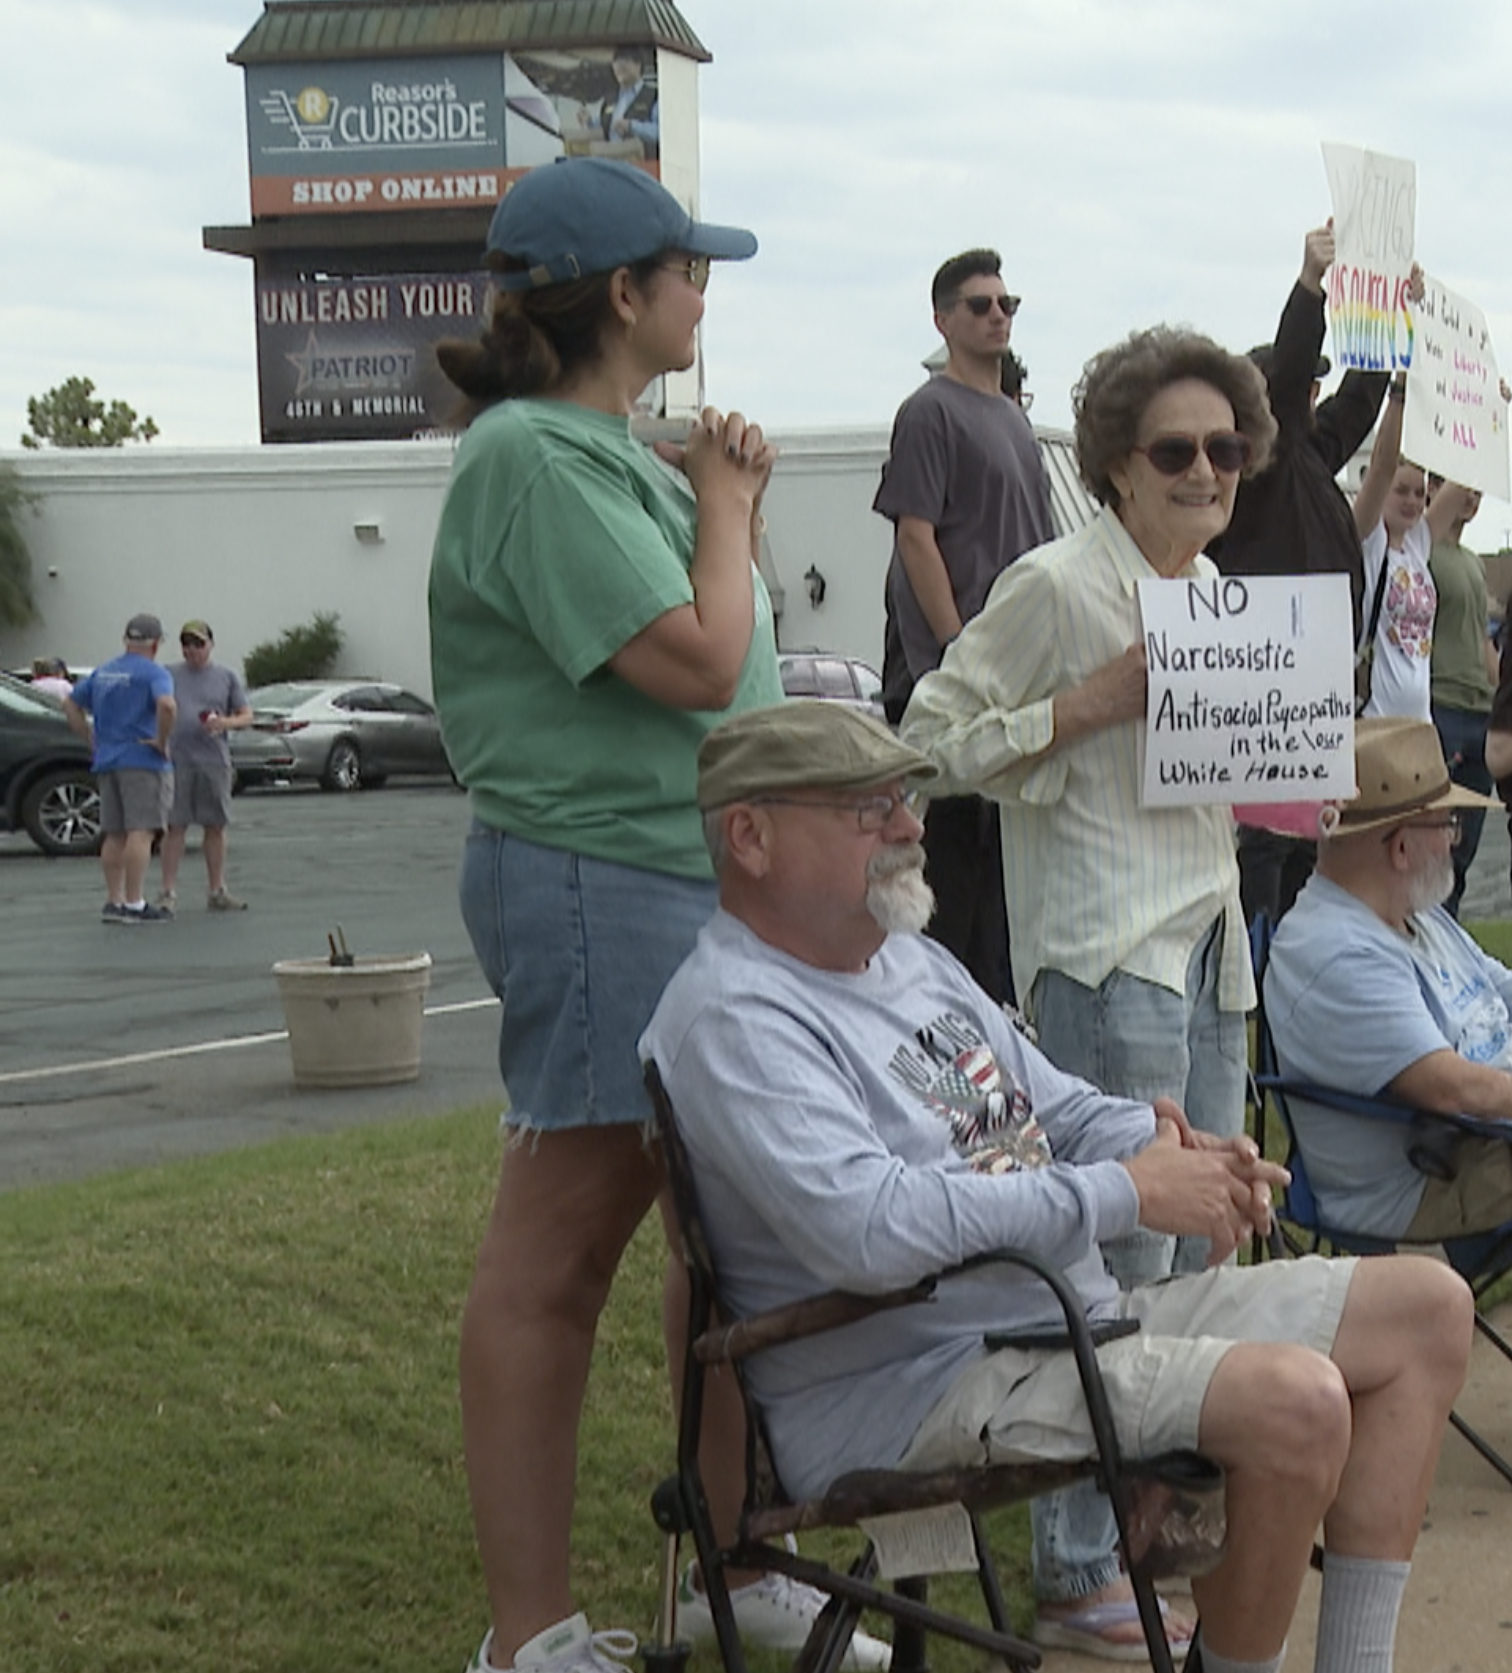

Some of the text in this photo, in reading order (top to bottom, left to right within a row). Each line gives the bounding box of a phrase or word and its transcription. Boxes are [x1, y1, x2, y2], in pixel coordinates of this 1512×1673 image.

[304, 91, 321, 117] R
[371, 78, 457, 104] Reasor's
[339, 101, 487, 143] CURBSIDE
[292, 178, 374, 205] SHOP
[380, 174, 498, 201] ONLINE
[261, 285, 389, 325] UNLEASH
[400, 281, 475, 319] YOUR
[310, 354, 413, 380] PATRIOT
[352, 396, 426, 416] MEMORIAL
[1453, 419, 1477, 449] ALL
[1187, 578, 1249, 622] NO
[1147, 630, 1296, 672] Narcissistic
[1155, 687, 1263, 733] Antisocial
[1230, 733, 1250, 759] in
[1256, 731, 1300, 753] the
[1159, 759, 1329, 785] White House
